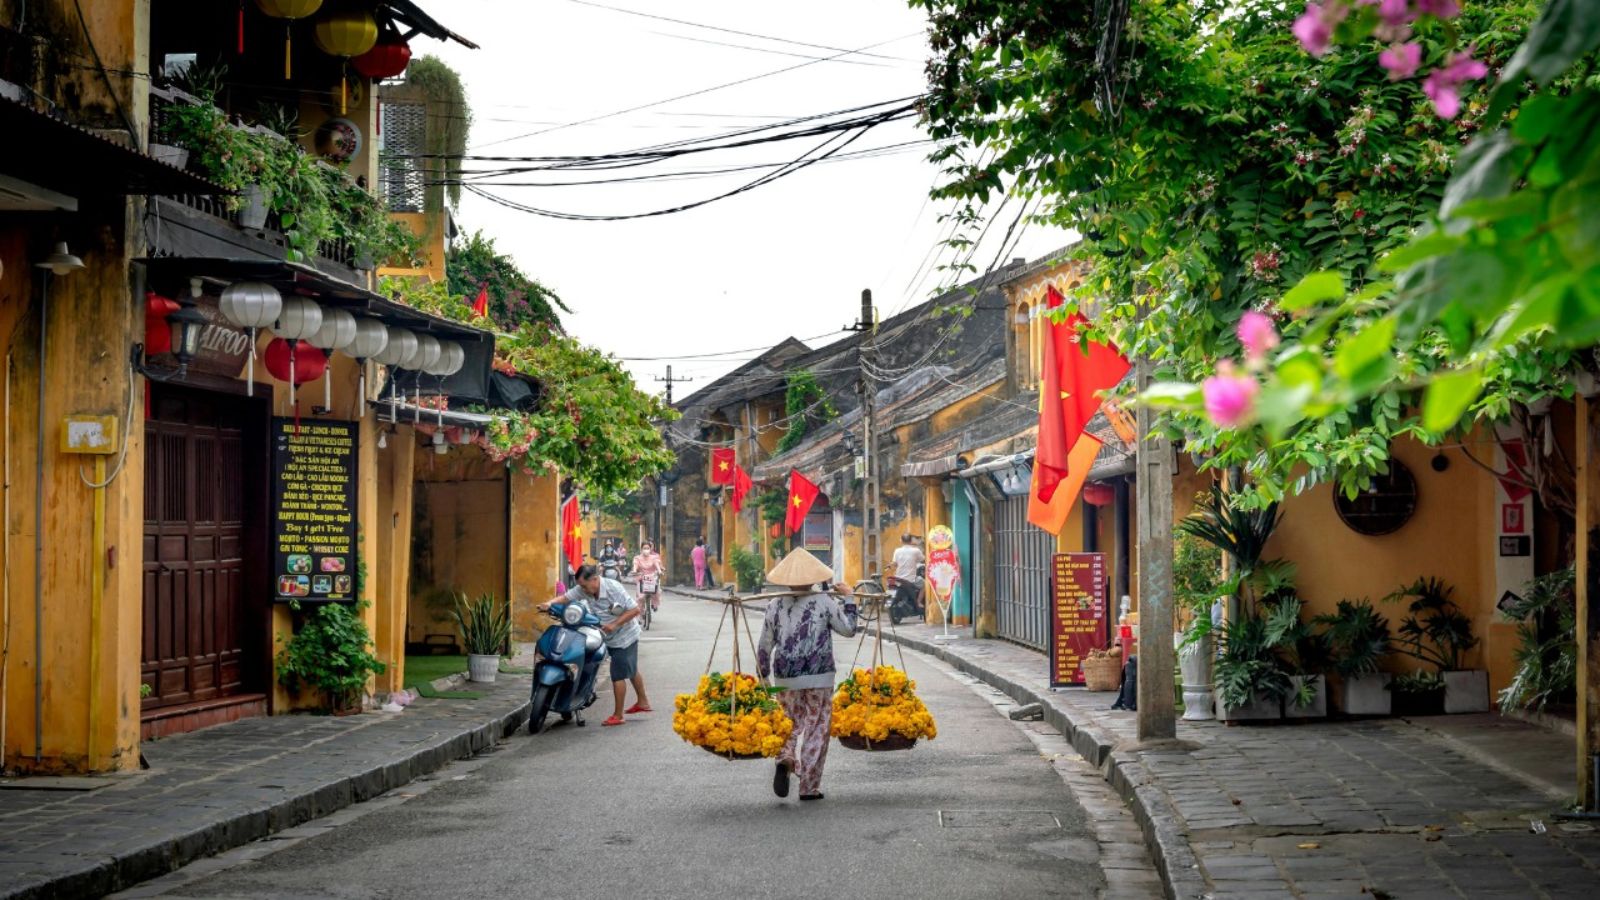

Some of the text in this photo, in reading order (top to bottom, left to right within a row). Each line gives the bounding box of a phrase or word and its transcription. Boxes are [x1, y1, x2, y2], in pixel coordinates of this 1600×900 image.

[278, 512, 295, 520] HAPPY
[296, 512, 309, 520] HOUR
[286, 524, 302, 534] Buy
[280, 534, 350, 544] MOJITO PASSION MOJITO
